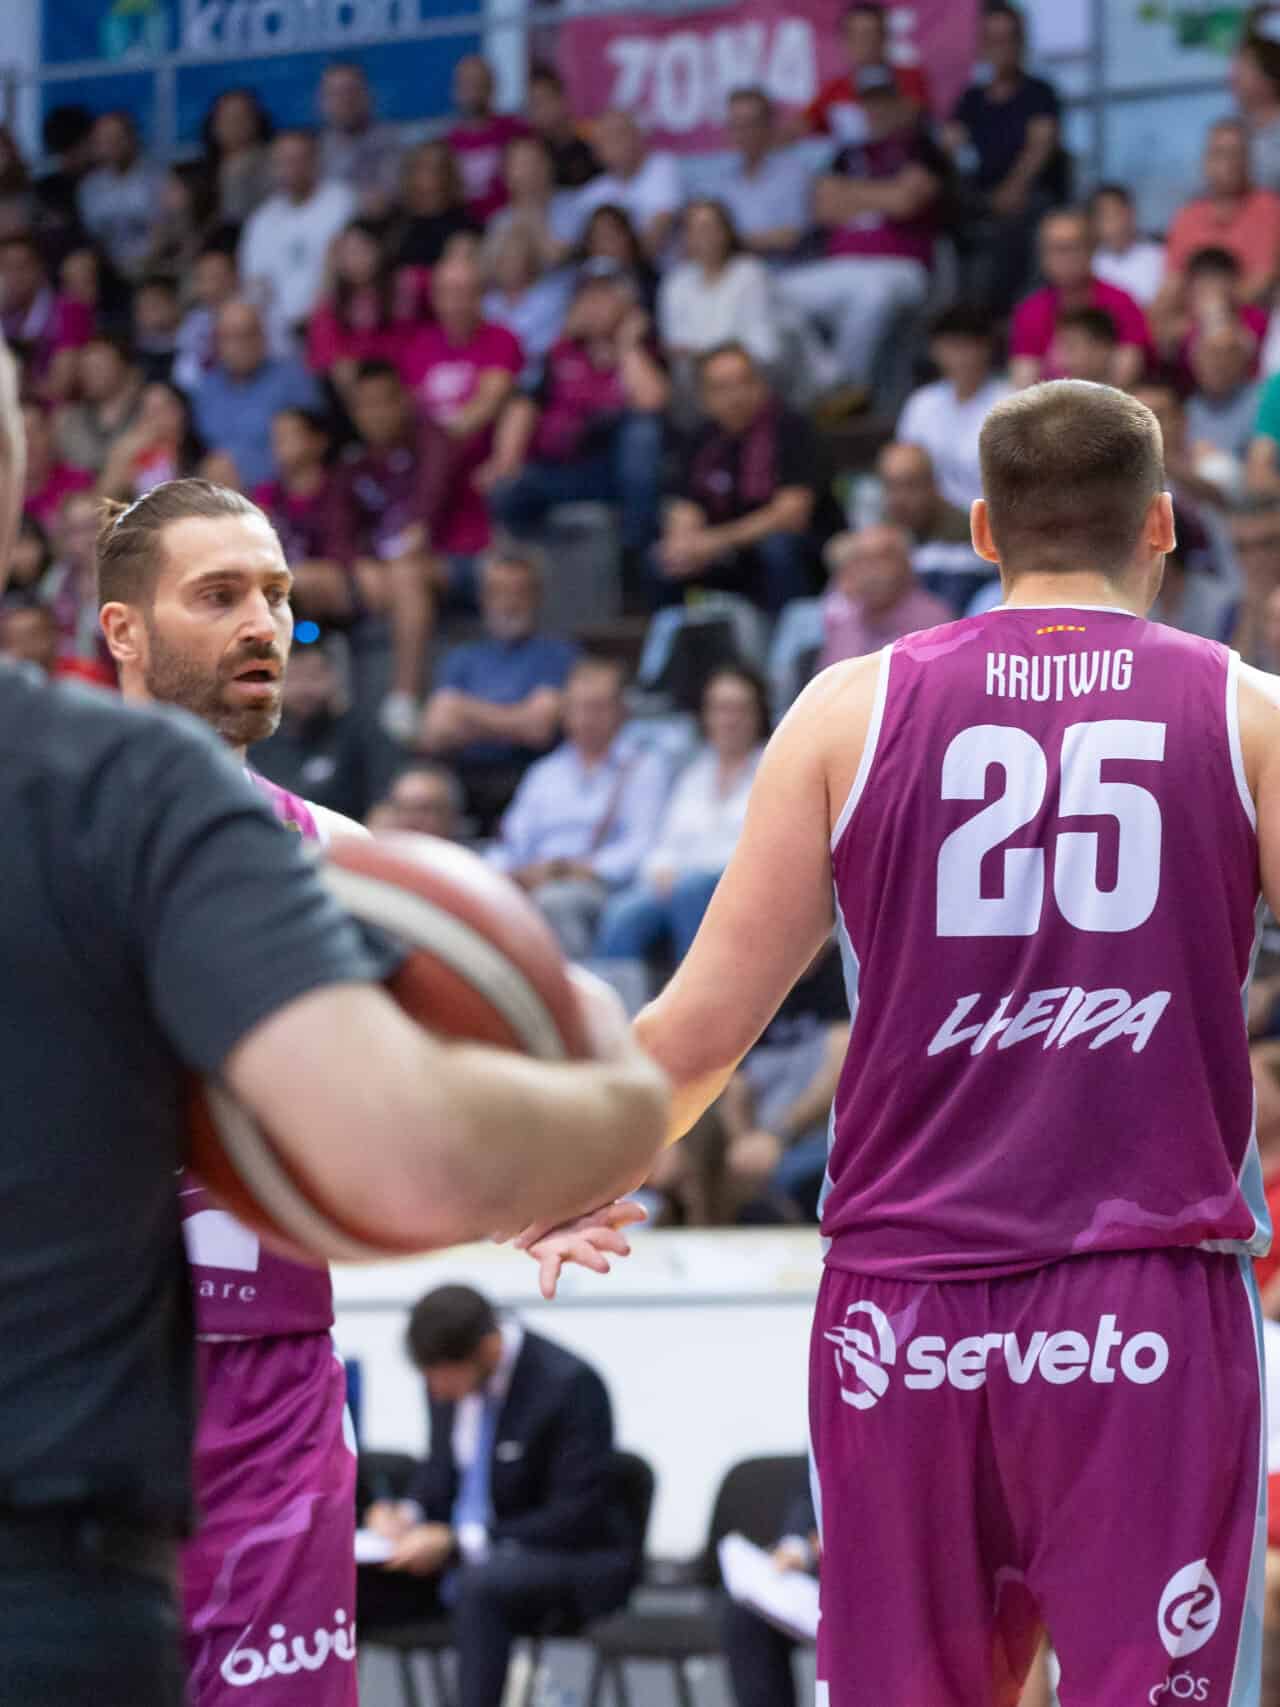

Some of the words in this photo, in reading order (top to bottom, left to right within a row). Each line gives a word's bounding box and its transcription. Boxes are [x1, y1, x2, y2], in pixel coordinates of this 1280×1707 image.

[985, 648, 1134, 702] KRUTWIG
[936, 718, 1168, 938] 25
[903, 1314, 1170, 1391] serveto
